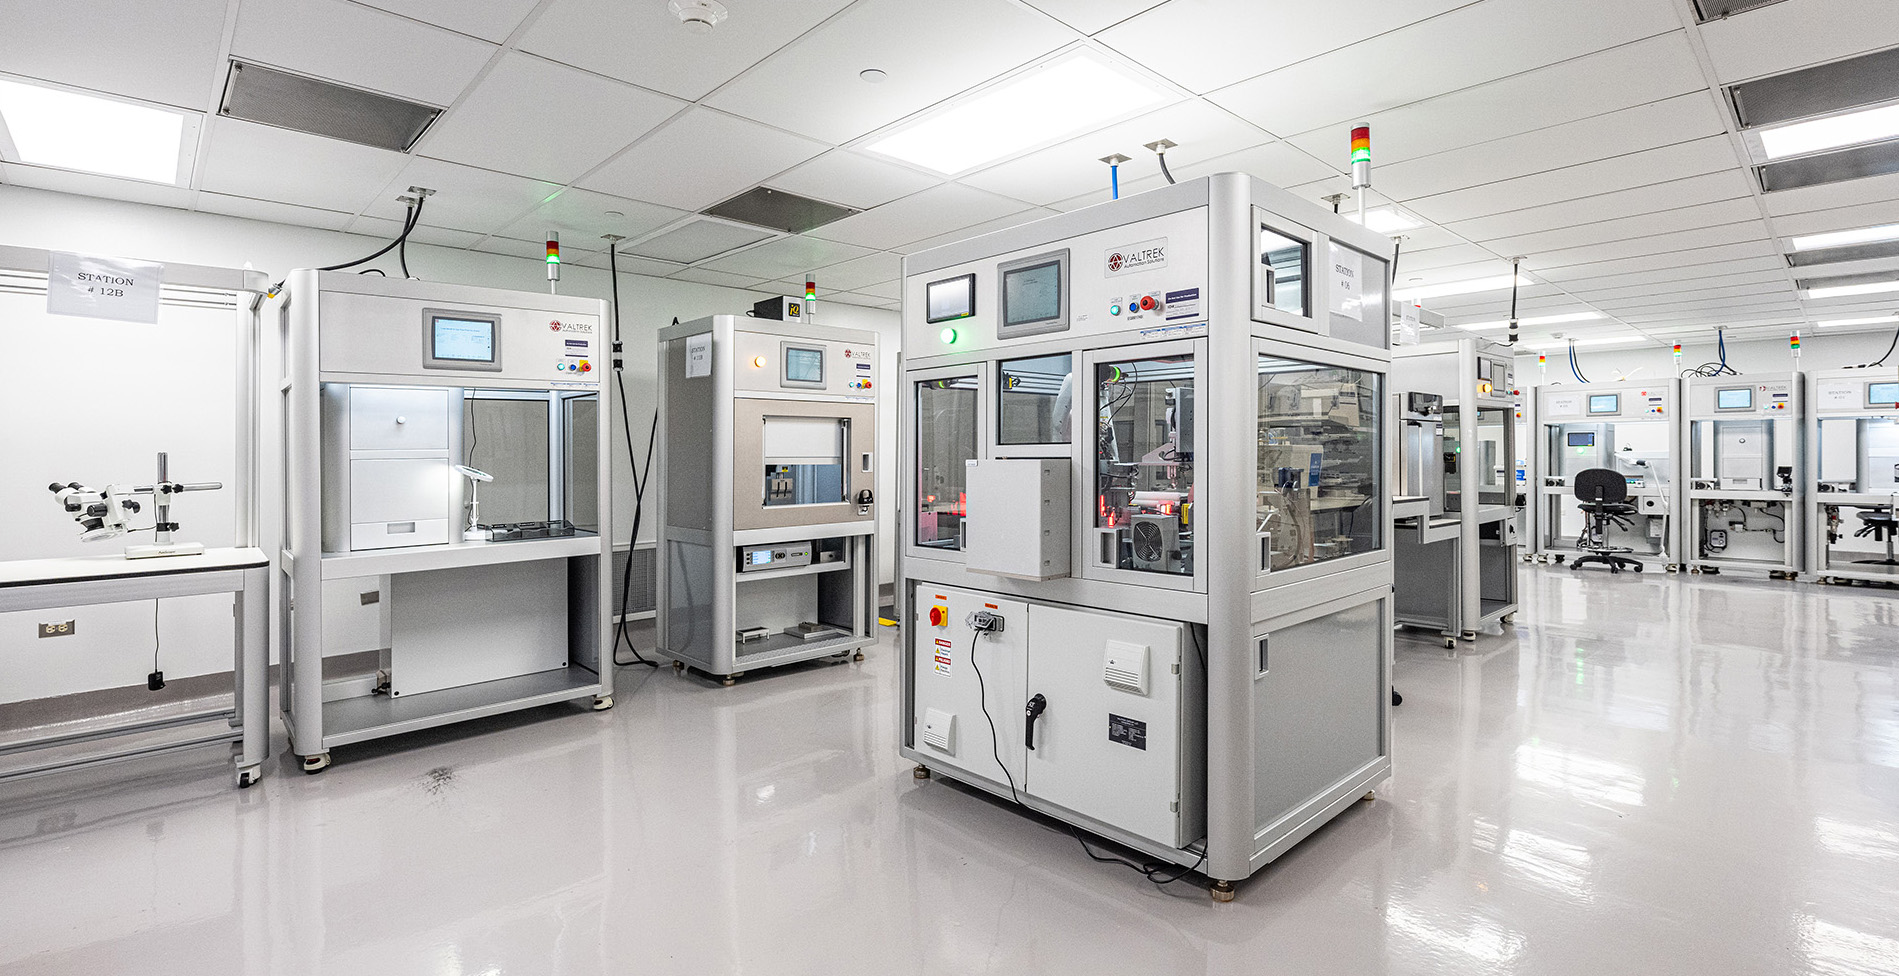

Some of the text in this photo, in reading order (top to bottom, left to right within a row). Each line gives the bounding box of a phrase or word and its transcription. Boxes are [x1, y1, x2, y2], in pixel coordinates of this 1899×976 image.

[1122, 247, 1165, 263] VALTREK
[1124, 257, 1165, 269] Automation Solutions
[1335, 263, 1354, 278] STATION
[77, 272, 134, 287] STATION
[100, 287, 124, 297] 12B
[561, 323, 592, 331] VALTREK
